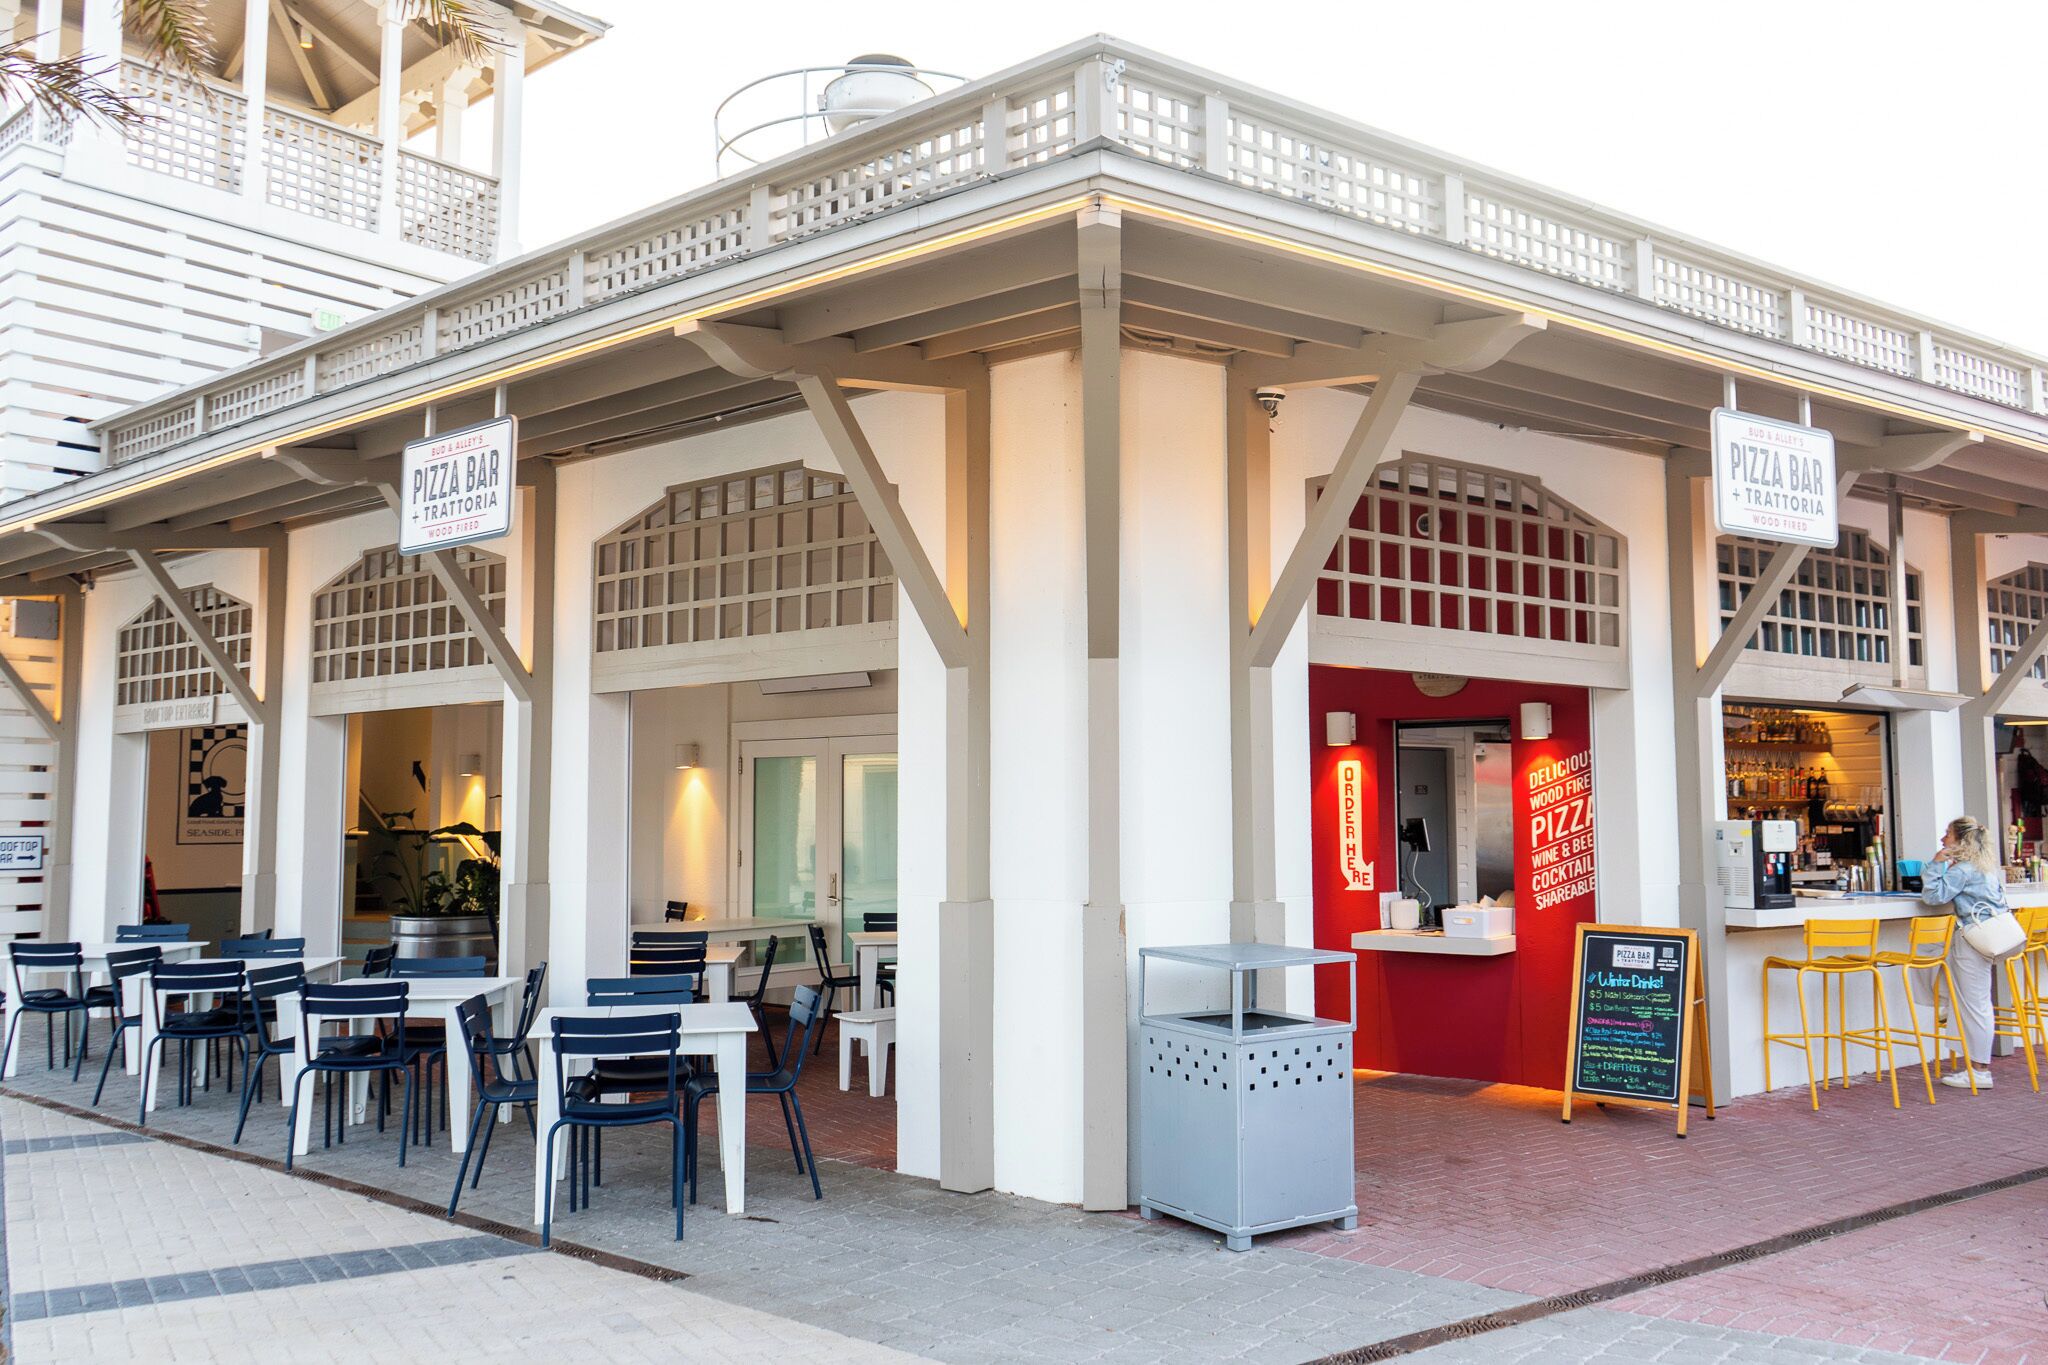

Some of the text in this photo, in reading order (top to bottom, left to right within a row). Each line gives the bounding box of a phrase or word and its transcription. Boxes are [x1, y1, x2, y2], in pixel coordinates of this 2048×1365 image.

[432, 435, 483, 456] BUD & ALLEY'S
[1749, 427, 1804, 447] BUD & ALLEY'S
[412, 449, 499, 505] PIZZA BAR
[1730, 441, 1824, 497] PIZZA BAR
[424, 491, 498, 522] TRATTORIA
[1746, 487, 1825, 516] TRATTORIA
[428, 521, 479, 538] WOOD FIRED
[1753, 514, 1807, 531] WOOD FIRED
[143, 701, 210, 724] ROOFTOP ENTRANCE
[1343, 766, 1356, 839] ORDER
[1529, 784, 1564, 811] WOOD
[1346, 843, 1371, 887] HERE
[1532, 846, 1560, 870] WINE
[1562, 842, 1571, 858] &
[1616, 949, 1651, 960] PIZZA BAR
[1597, 971, 1665, 989] Winter Drinks!
[1589, 989, 1603, 999] $5
[1589, 1002, 1602, 1012] $5
